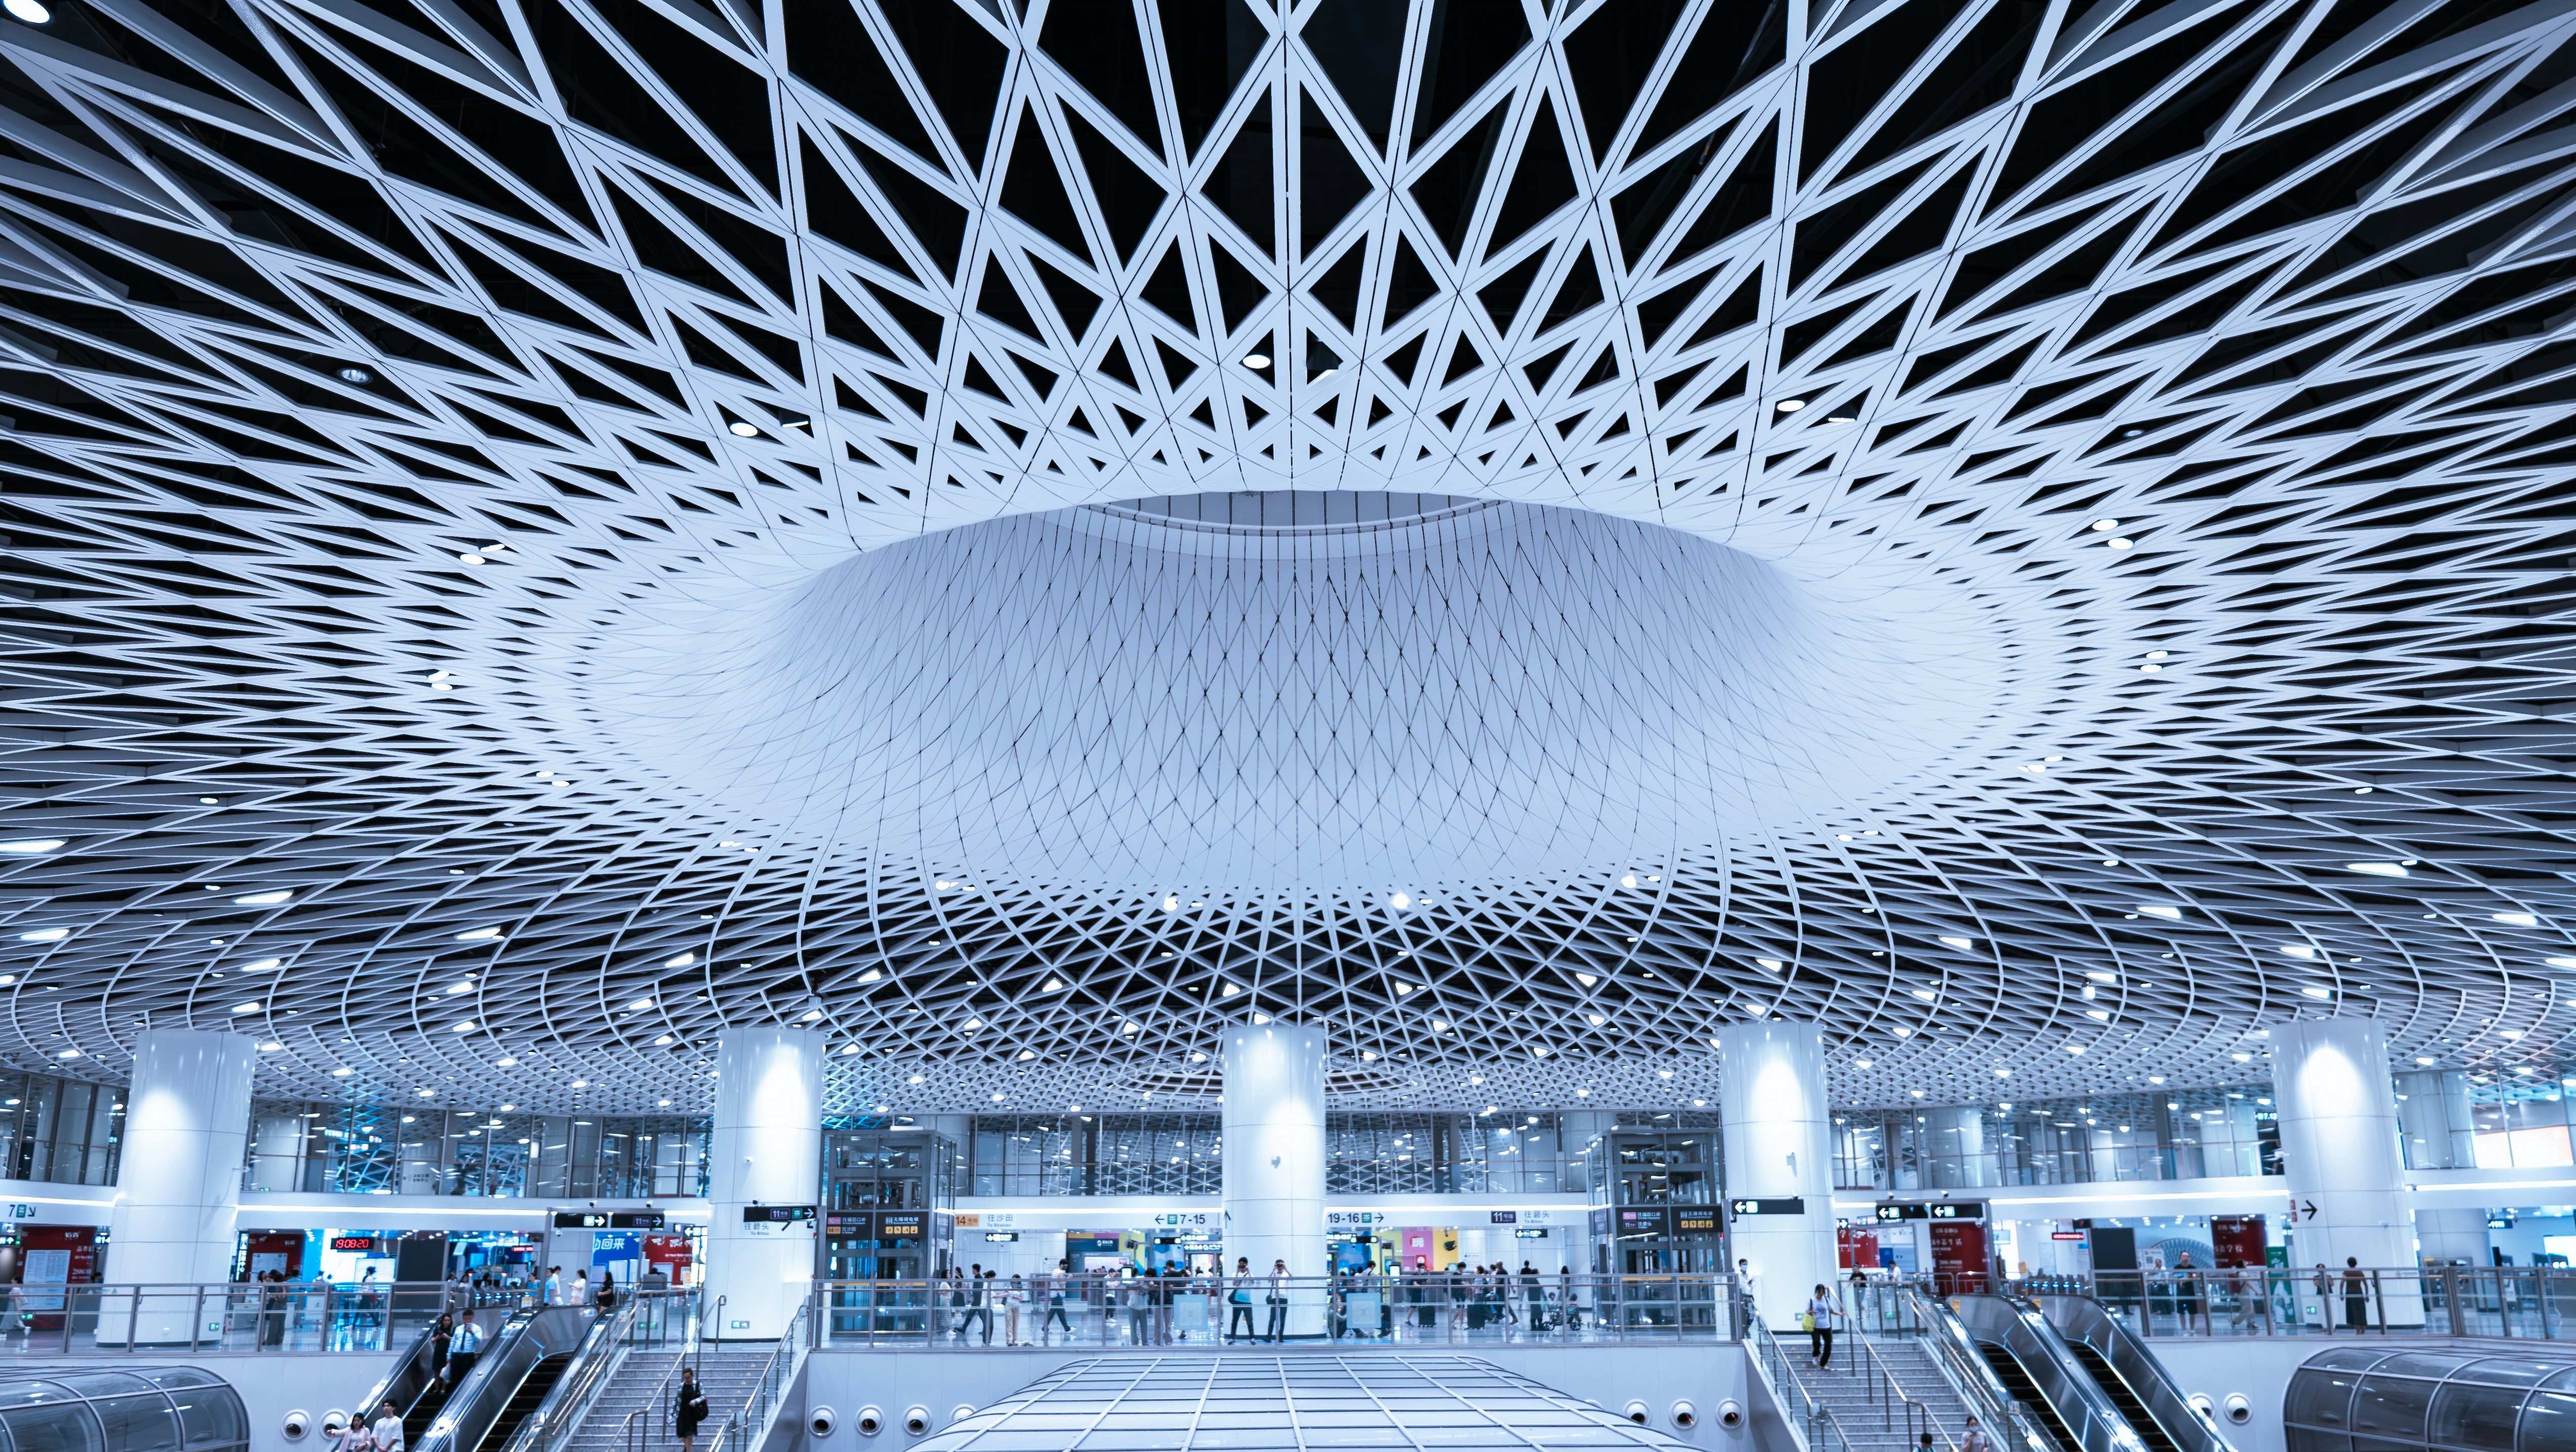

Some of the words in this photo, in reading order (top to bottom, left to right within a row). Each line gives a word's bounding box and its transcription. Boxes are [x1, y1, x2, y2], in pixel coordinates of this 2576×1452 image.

[9, 1205, 16, 1217] 7
[1180, 1214, 1205, 1224] 7-15
[1328, 1213, 1359, 1223] 19-16
